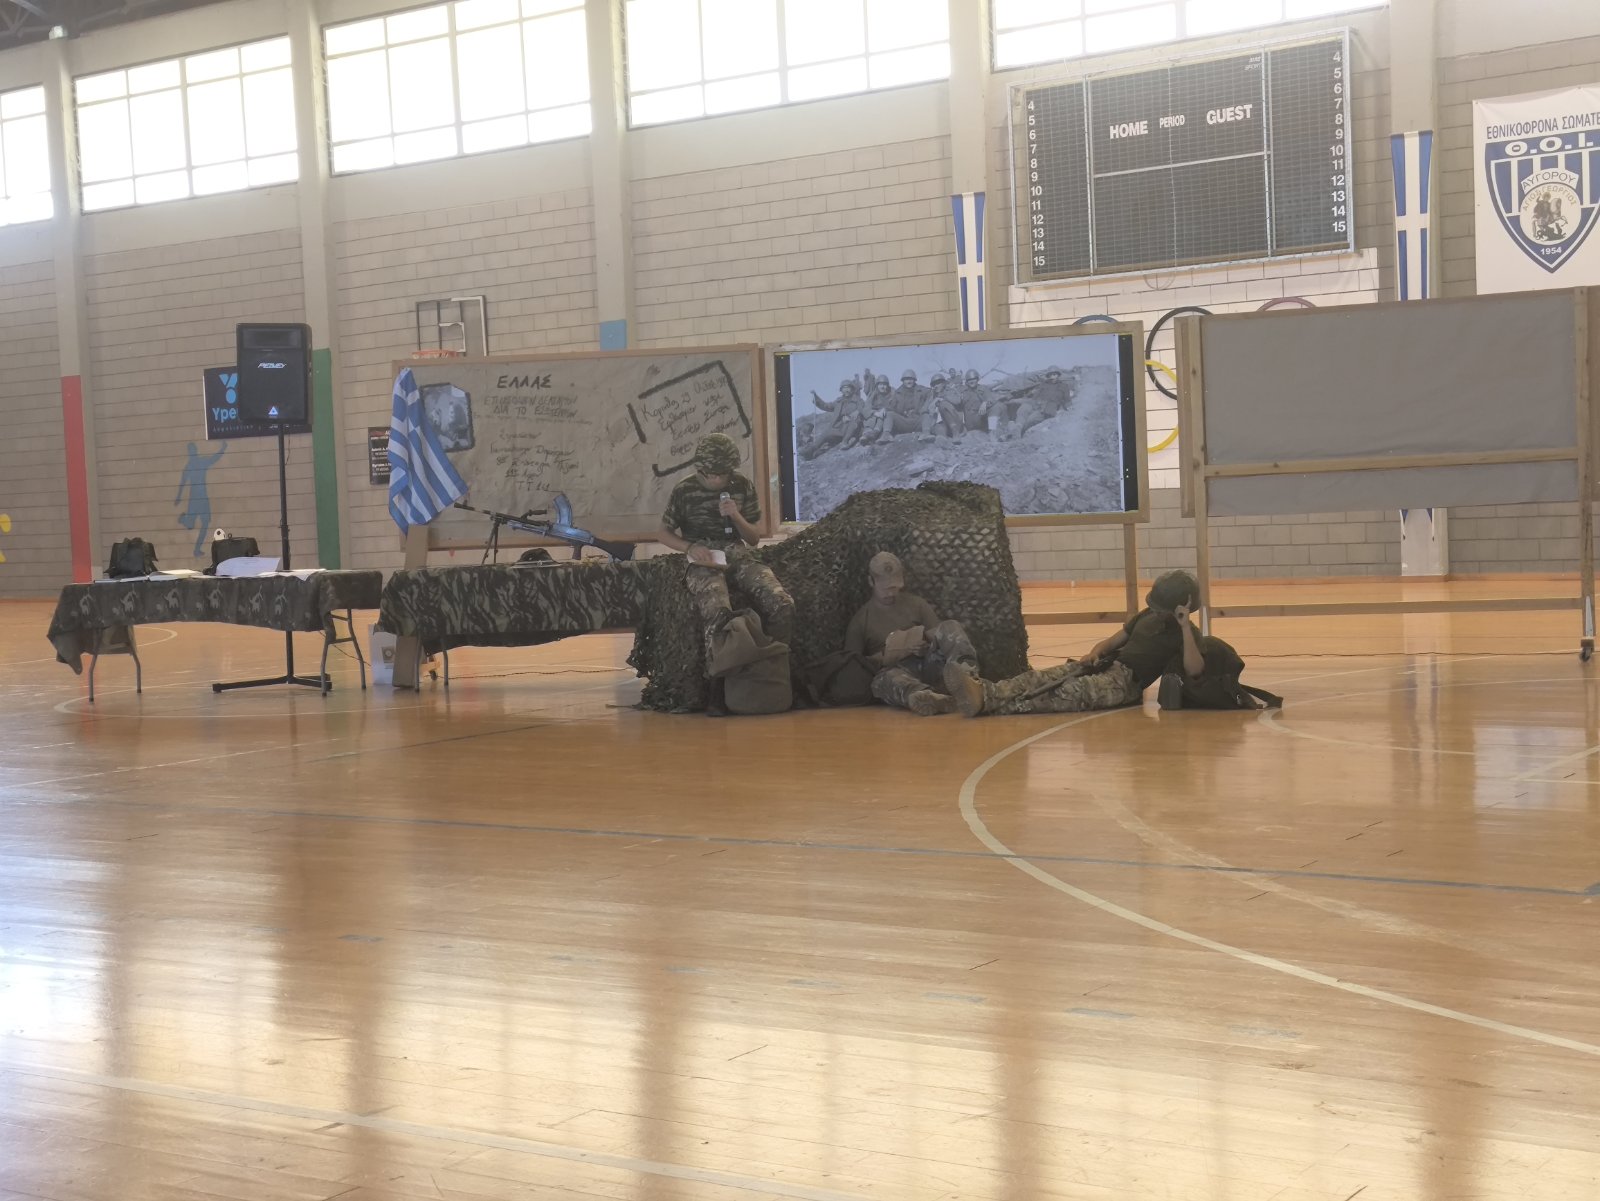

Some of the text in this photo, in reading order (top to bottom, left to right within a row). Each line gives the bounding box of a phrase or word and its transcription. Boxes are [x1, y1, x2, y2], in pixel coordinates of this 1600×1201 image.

[1332, 52, 1342, 61] 4
[1333, 68, 1342, 78] 5
[1333, 83, 1343, 93] 6
[1027, 101, 1035, 111] 4
[1334, 98, 1343, 108] 7
[1028, 115, 1036, 126] 5
[1110, 104, 1252, 139] HOME PERIOD GUEST
[1334, 114, 1343, 124] 8
[1335, 129, 1344, 139] 9
[1486, 118, 1559, 140] ΕΘΝΙΚΟΦΡΟΝΑ
[1028, 130, 1037, 140] 6
[1029, 144, 1038, 155] 7
[1330, 145, 1343, 156] 10
[1030, 159, 1038, 169] 8
[1333, 159, 1343, 170] 11
[1030, 172, 1039, 182] 9
[1331, 175, 1344, 185] 12
[1522, 171, 1577, 191] ΑΥΓΟΡΟΥ
[1030, 186, 1043, 197] 10
[1332, 191, 1345, 201] 13
[1031, 200, 1041, 211] 11
[1332, 206, 1345, 216] 14
[1031, 215, 1044, 225] 12
[1333, 221, 1345, 232] 15
[1032, 228, 1045, 239] 13
[1032, 241, 1045, 252] 14
[1540, 246, 1562, 255] 1954
[1033, 256, 1046, 267] 15
[497, 373, 553, 390] ΕΛΛΑΣ
